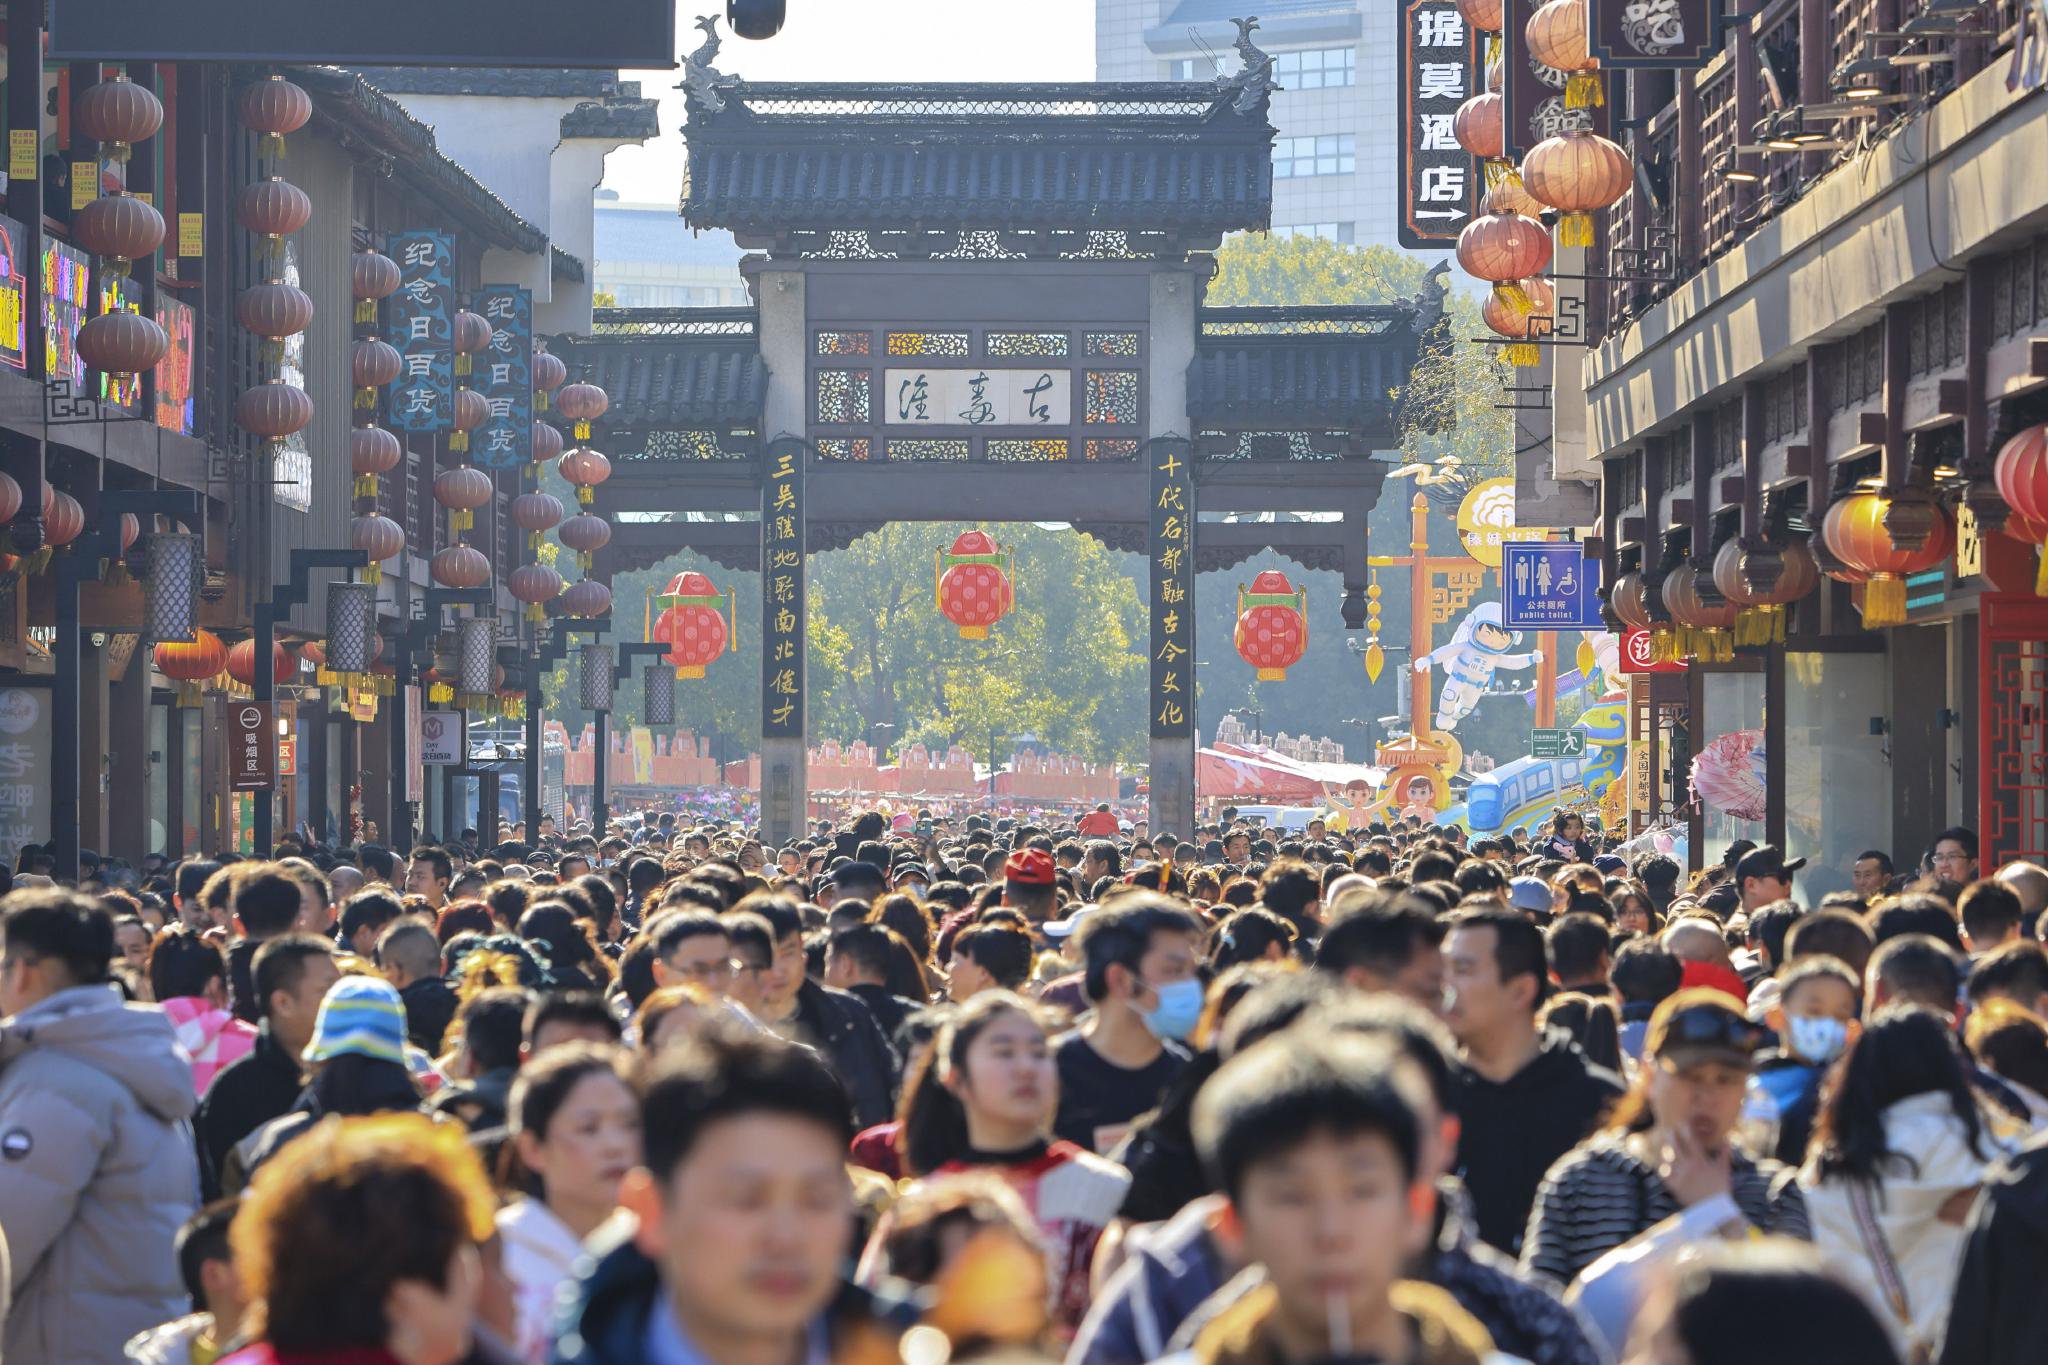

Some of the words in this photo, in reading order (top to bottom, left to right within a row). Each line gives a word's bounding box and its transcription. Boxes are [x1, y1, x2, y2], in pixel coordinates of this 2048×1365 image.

[1418, 10, 1465, 202] 提莫酒店
[404, 242, 437, 413] 纪念日百货
[486, 296, 516, 451] 纪念日百货
[1157, 453, 1187, 726] 十代名都融古今文化
[1519, 611, 1545, 619] public
[1548, 611, 1573, 619] toilet
[1527, 600, 1567, 610] 公共厕所
[245, 732, 258, 771] 吸烟区
[1638, 750, 1649, 802] 全国可邮寄
